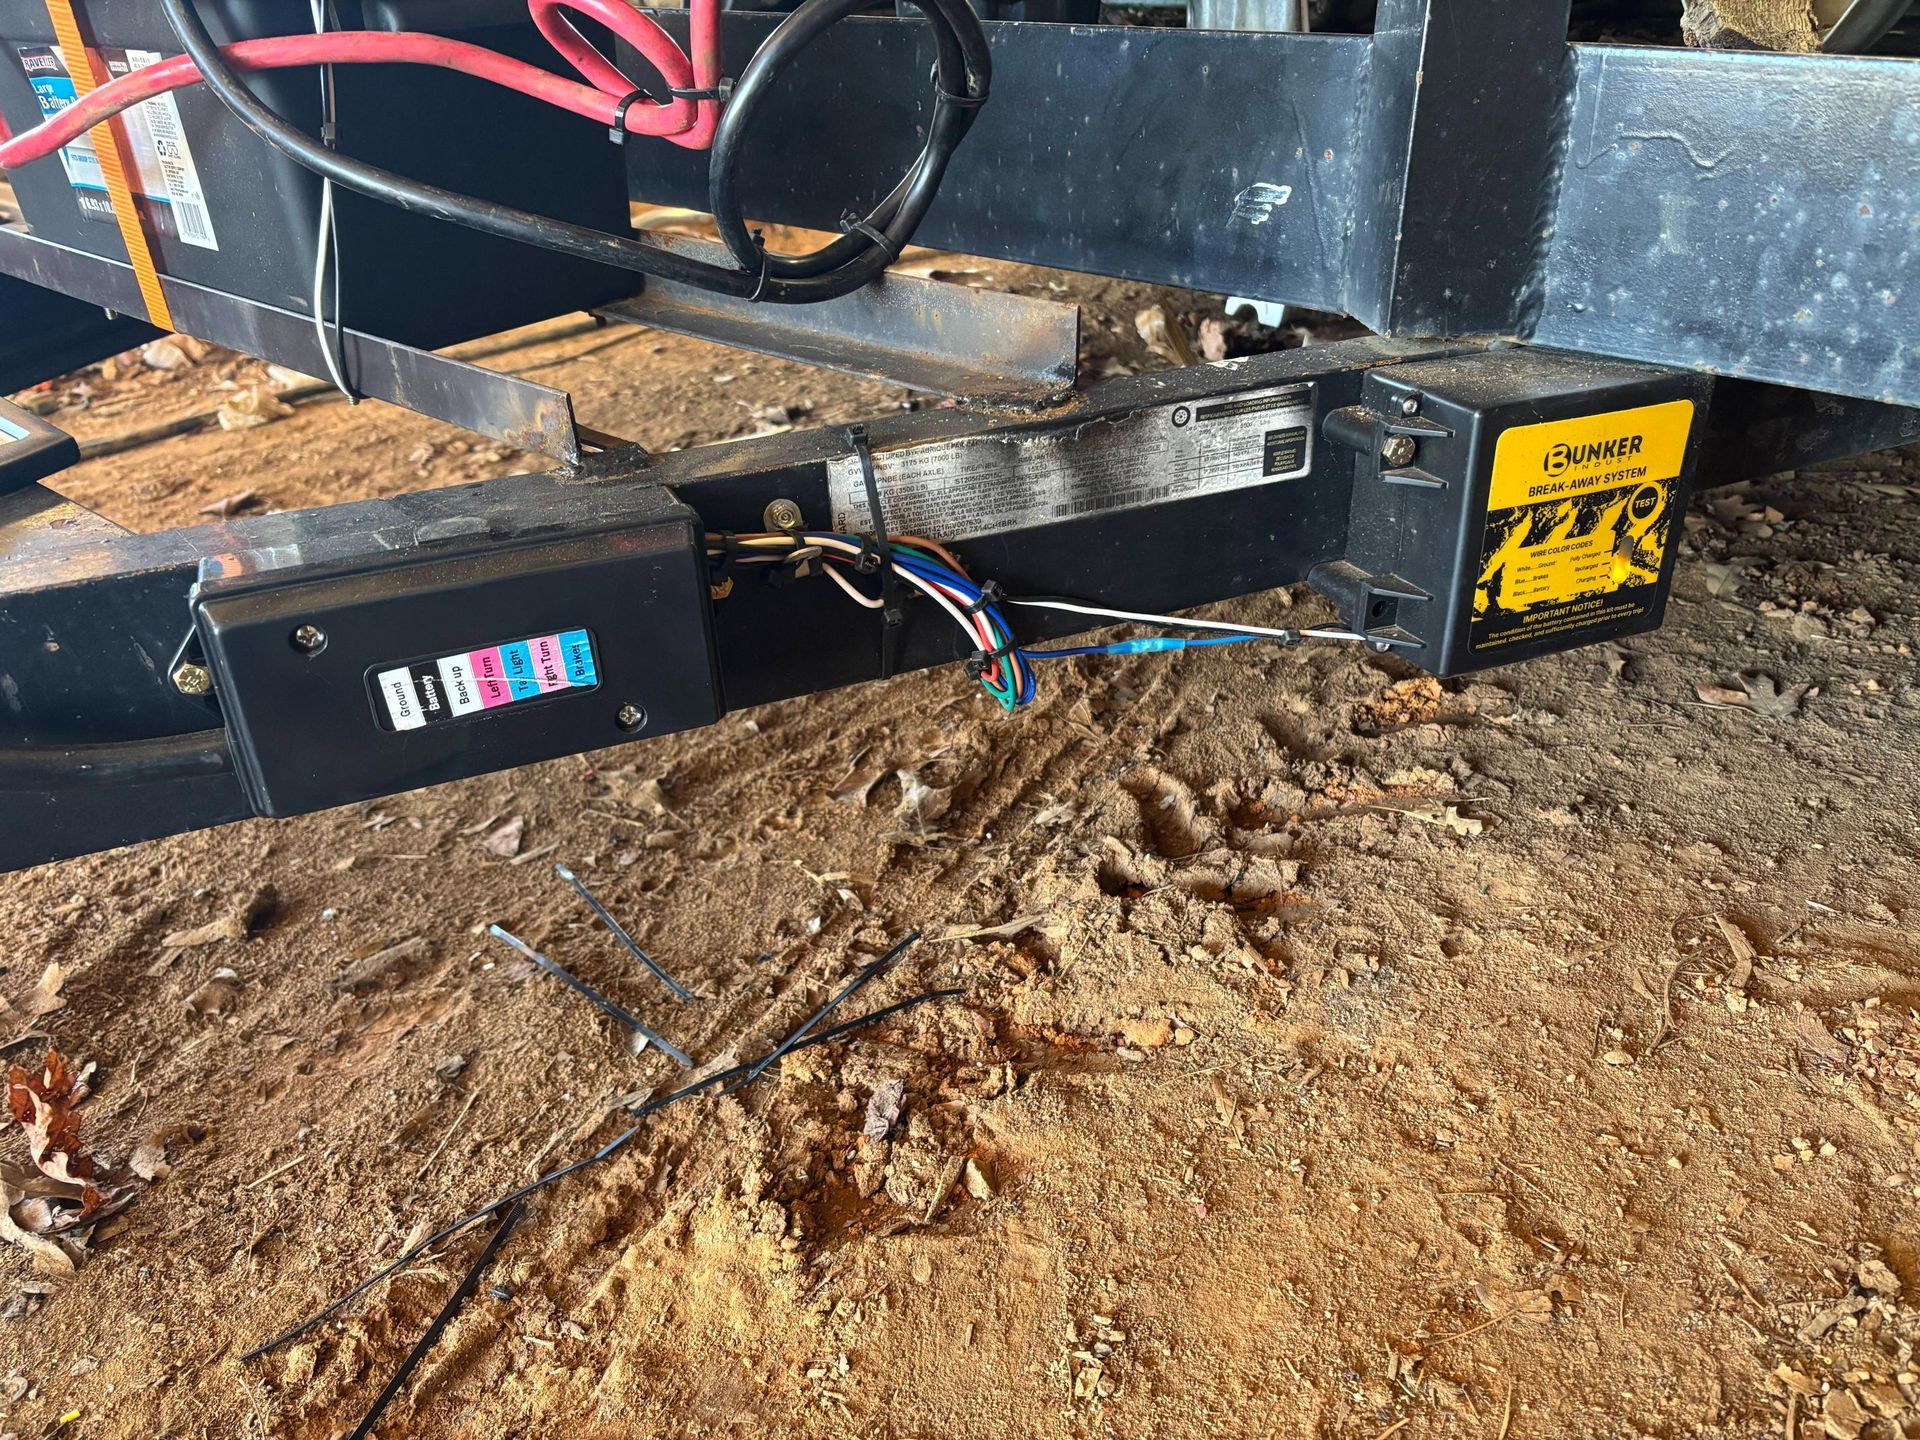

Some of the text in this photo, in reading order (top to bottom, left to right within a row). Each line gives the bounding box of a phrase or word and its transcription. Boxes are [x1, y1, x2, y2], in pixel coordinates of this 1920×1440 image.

[901, 458, 917, 467] 3175
[918, 456, 928, 464] KG
[930, 452, 948, 463] (7000
[1544, 434, 1643, 477] BUNKER
[1574, 455, 1632, 471] INDUST
[898, 470, 920, 481] (EACH
[922, 466, 944, 477] AXLE)
[1528, 465, 1647, 498] BREAK-AWAY SYSTEM
[884, 488, 894, 496] KG
[896, 485, 914, 495] (3500
[894, 491, 926, 502] CONFORMS
[1635, 497, 1656, 508] TEST
[910, 520, 931, 528] CANADA
[912, 508, 934, 516] TOUTES
[1530, 540, 1594, 559] WIRE COLOR CODES
[1522, 599, 1603, 623] IMPORTANT NOTICE!
[1575, 618, 1597, 628] charged
[1617, 610, 1632, 618] every
[1500, 626, 1525, 636] condition
[1542, 618, 1562, 628] battery
[1562, 612, 1589, 622] contained
[509, 649, 525, 675] Light
[540, 641, 559, 688] Rght Turn
[571, 643, 586, 677] Brakes
[452, 665, 471, 706] Back up
[482, 656, 502, 700] Left Turn
[391, 682, 411, 718] Ground
[422, 675, 441, 712] Battery
